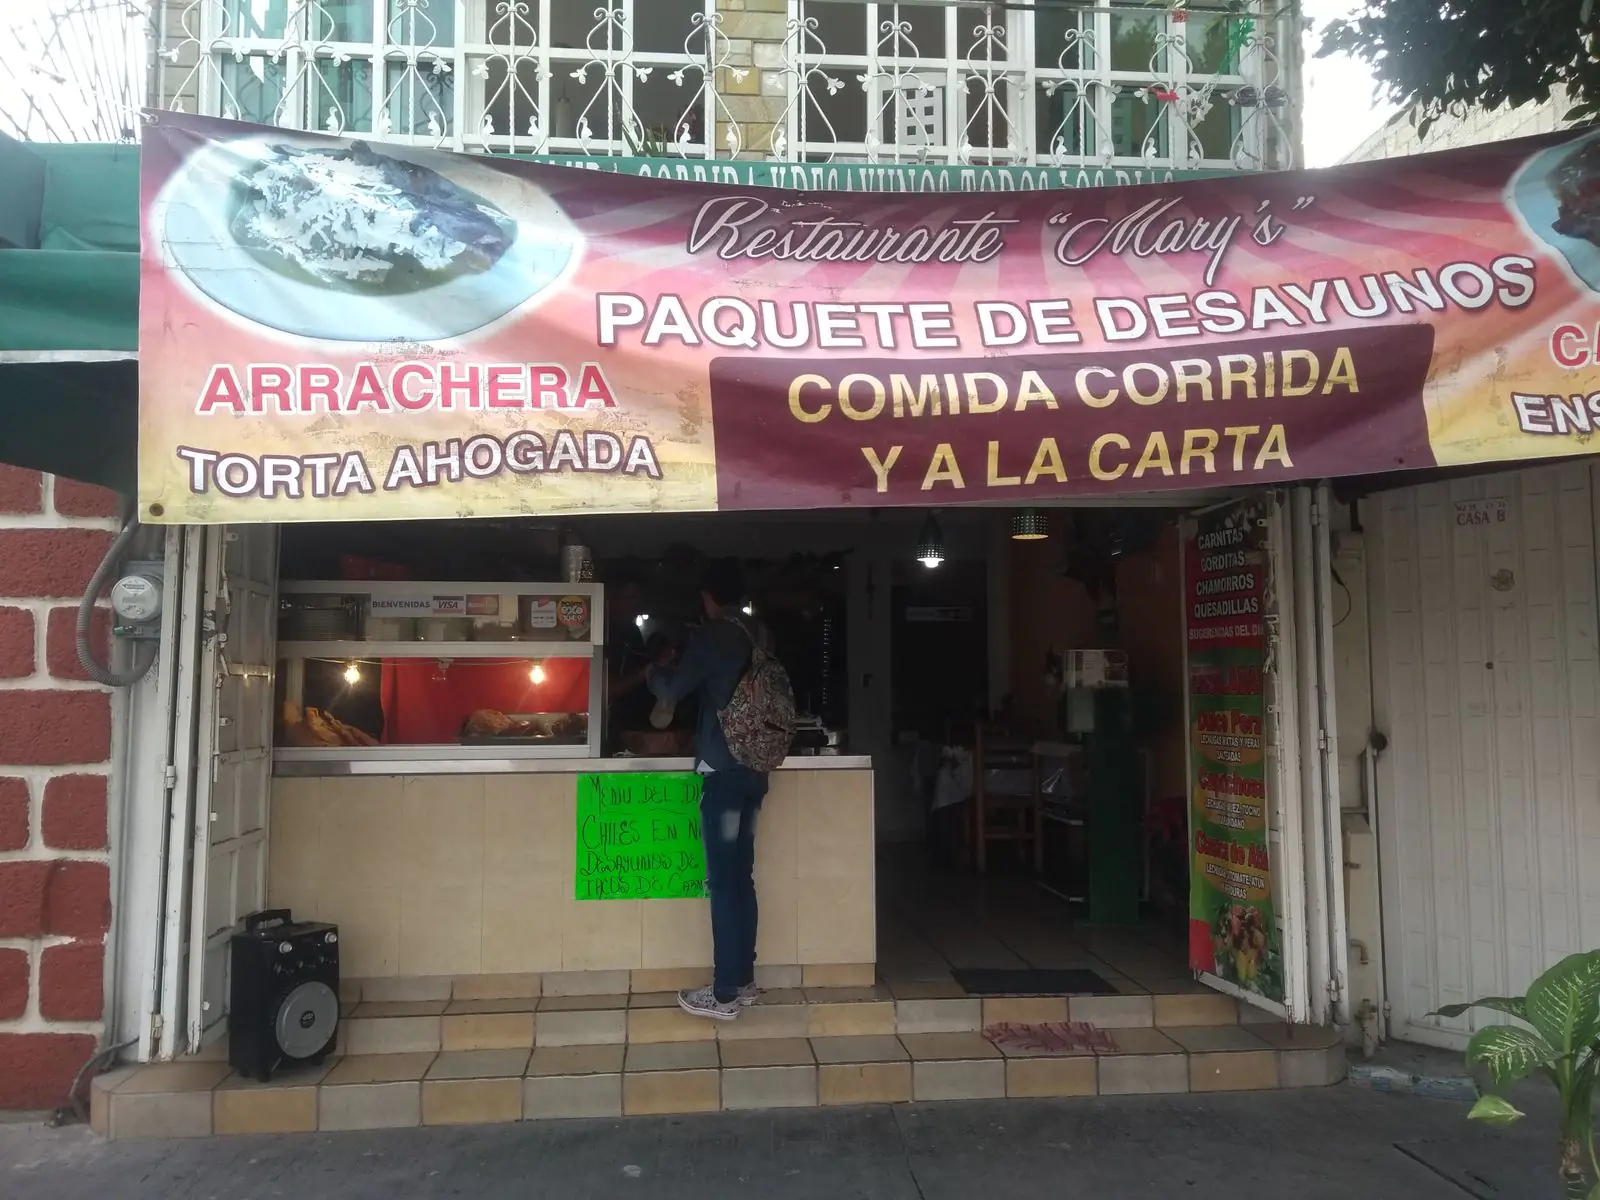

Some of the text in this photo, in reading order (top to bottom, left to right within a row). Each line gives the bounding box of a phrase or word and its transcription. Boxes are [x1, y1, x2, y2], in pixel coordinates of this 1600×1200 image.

[687, 195, 1020, 263] Restaurante
[596, 255, 1537, 350] PAQUETE DE DESAYUNOS
[1549, 321, 1600, 369] C
[197, 362, 618, 415] ARRACHERA
[789, 347, 1360, 423] COMIDA CORRIDA
[178, 431, 663, 498] TORTA AHOGADA
[861, 424, 1295, 493] Y A LA CARTA
[1456, 509, 1506, 526] CASA B
[1198, 526, 1244, 550] CARNITAS
[1201, 550, 1246, 572] GORDITAS
[1196, 573, 1255, 596] CHAMORROS
[372, 600, 431, 609] BIENVENIDAS
[437, 601, 459, 609] VISA
[1194, 597, 1259, 619] QUESADILLAS
[1189, 626, 1234, 640] SUGERENCIAS
[1235, 624, 1251, 637] DEL
[652, 819, 678, 842] EN
